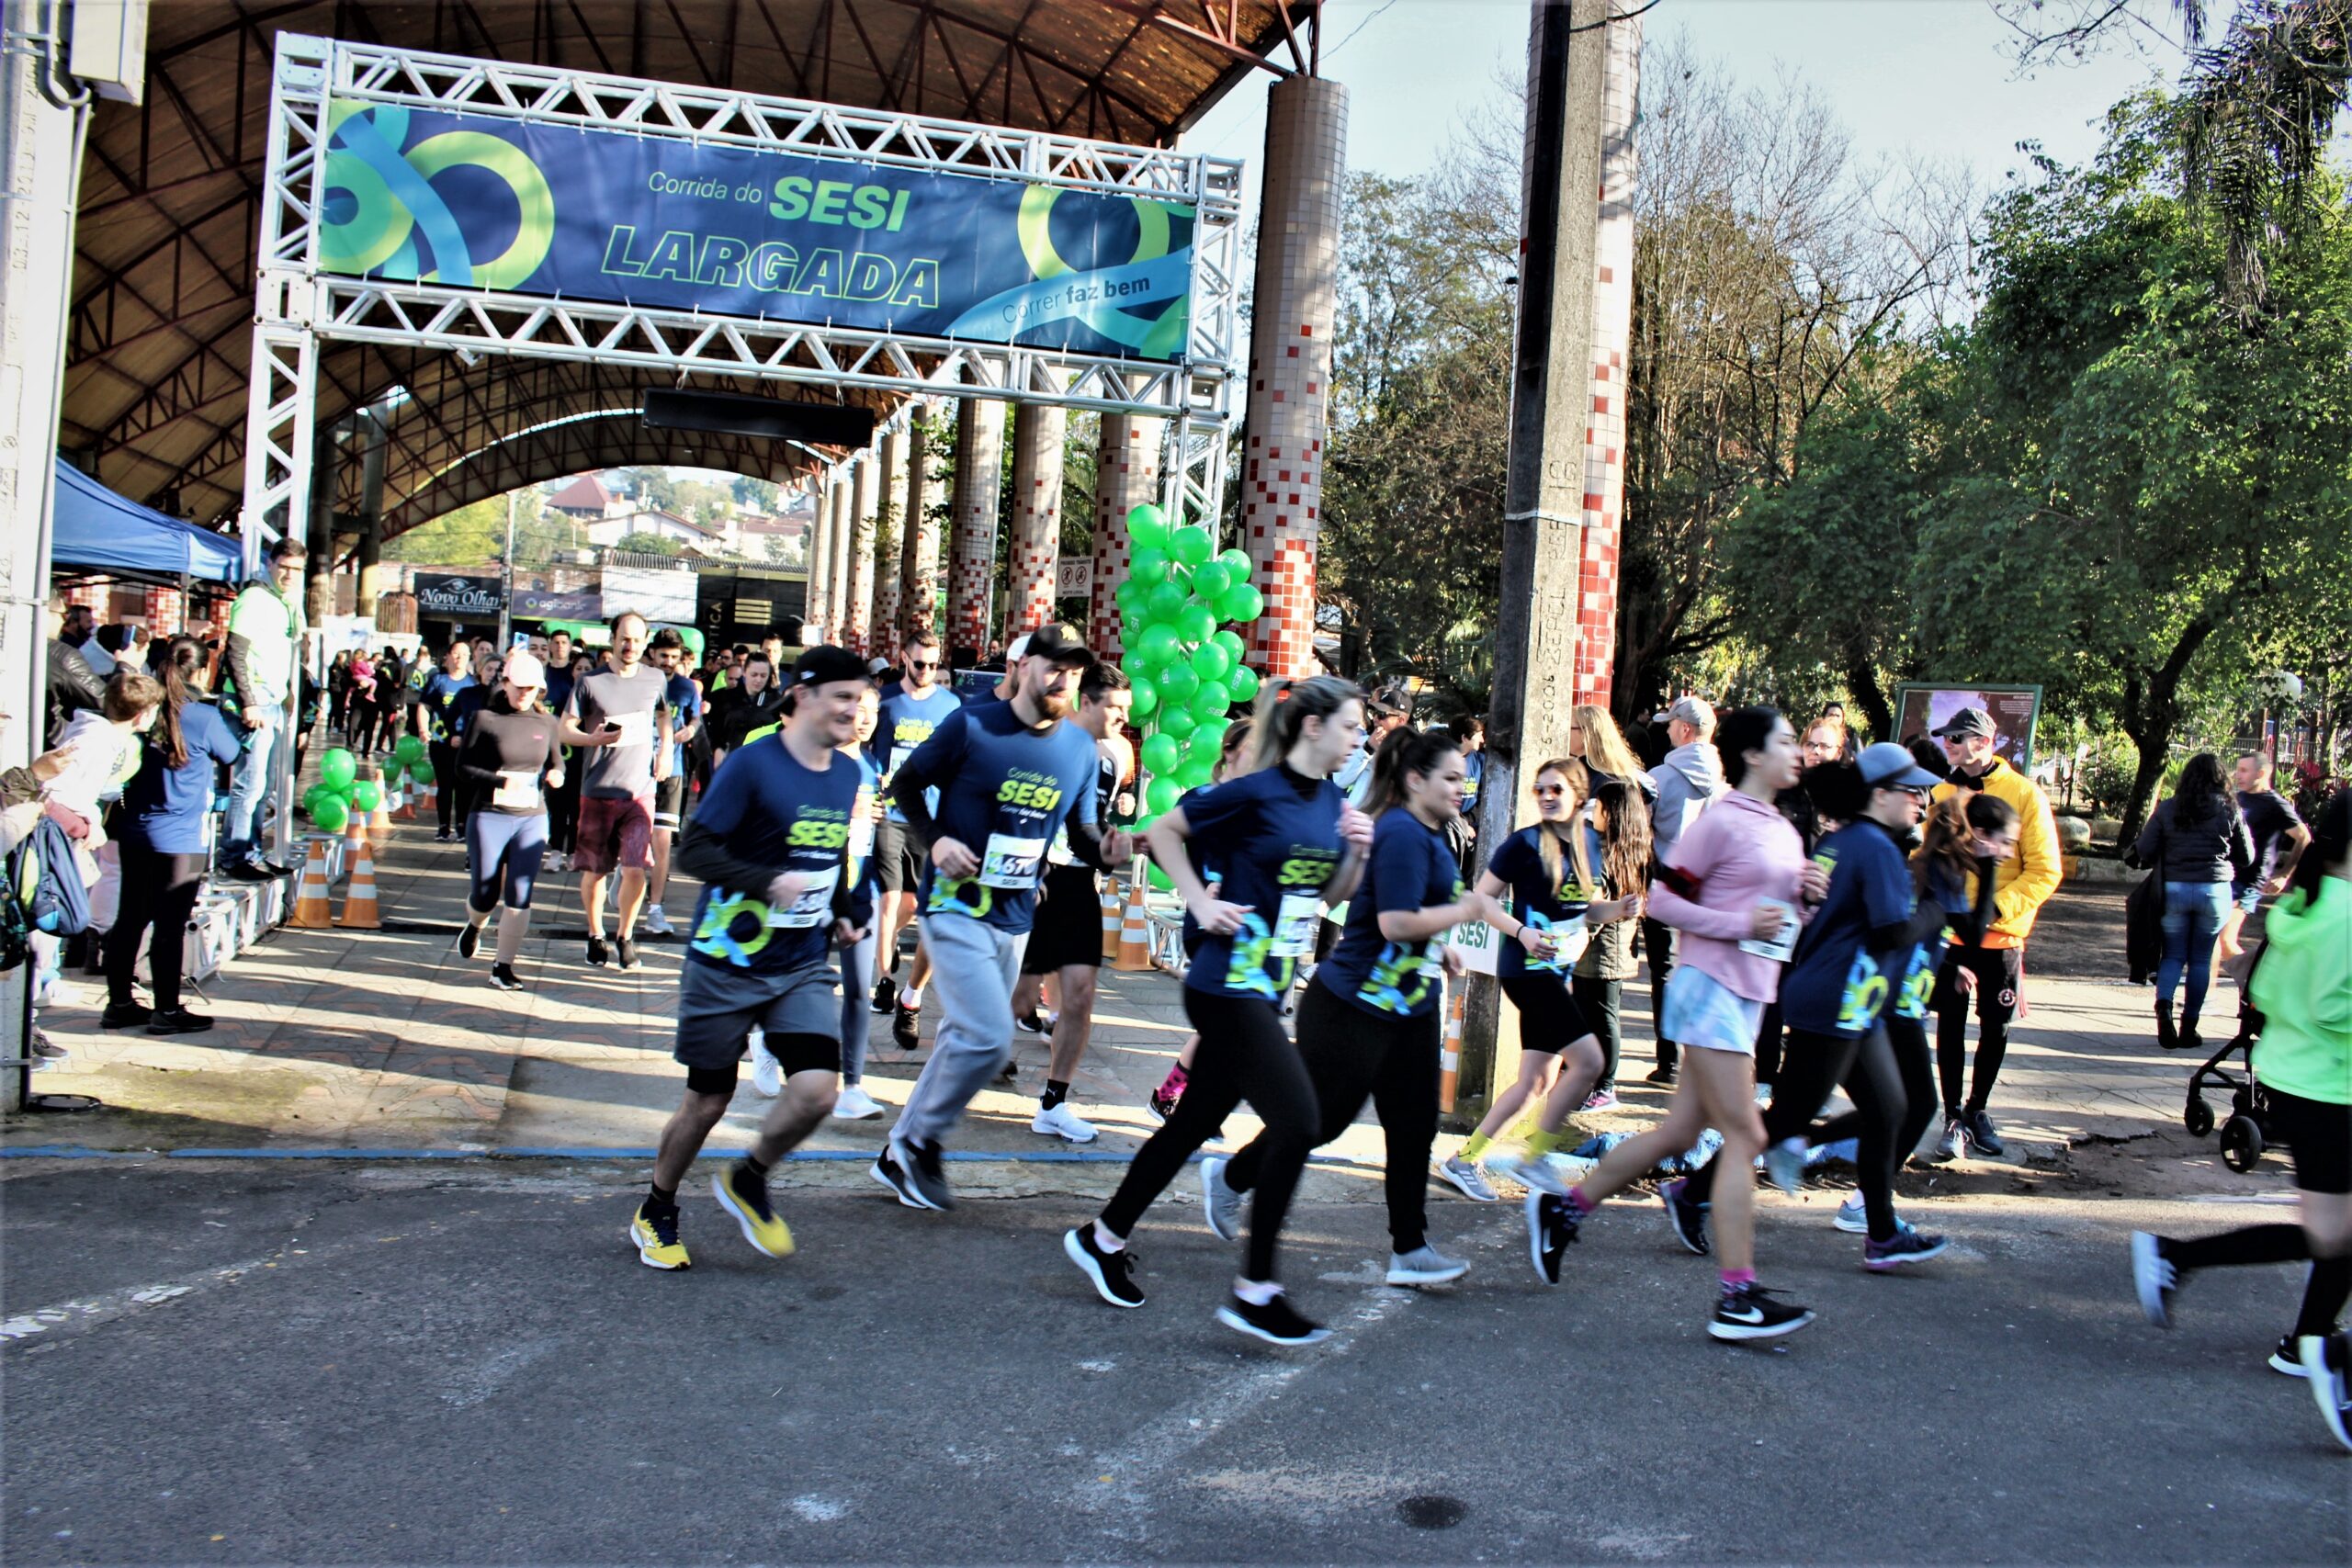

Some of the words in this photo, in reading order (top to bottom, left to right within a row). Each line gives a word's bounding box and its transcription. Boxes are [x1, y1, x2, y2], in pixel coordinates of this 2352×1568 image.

[649, 172, 728, 199] Corrida
[735, 182, 763, 203] do
[769, 176, 910, 231] SESI
[602, 224, 939, 309] LARGADA
[1001, 293, 1060, 323] Correr
[1066, 285, 1099, 304] faz
[1104, 276, 1150, 299] bem
[421, 588, 458, 604] Novo
[539, 598, 586, 611] agibank
[996, 779, 1063, 811] SESI
[786, 820, 850, 848] SESI
[1457, 921, 1489, 950] SESI
